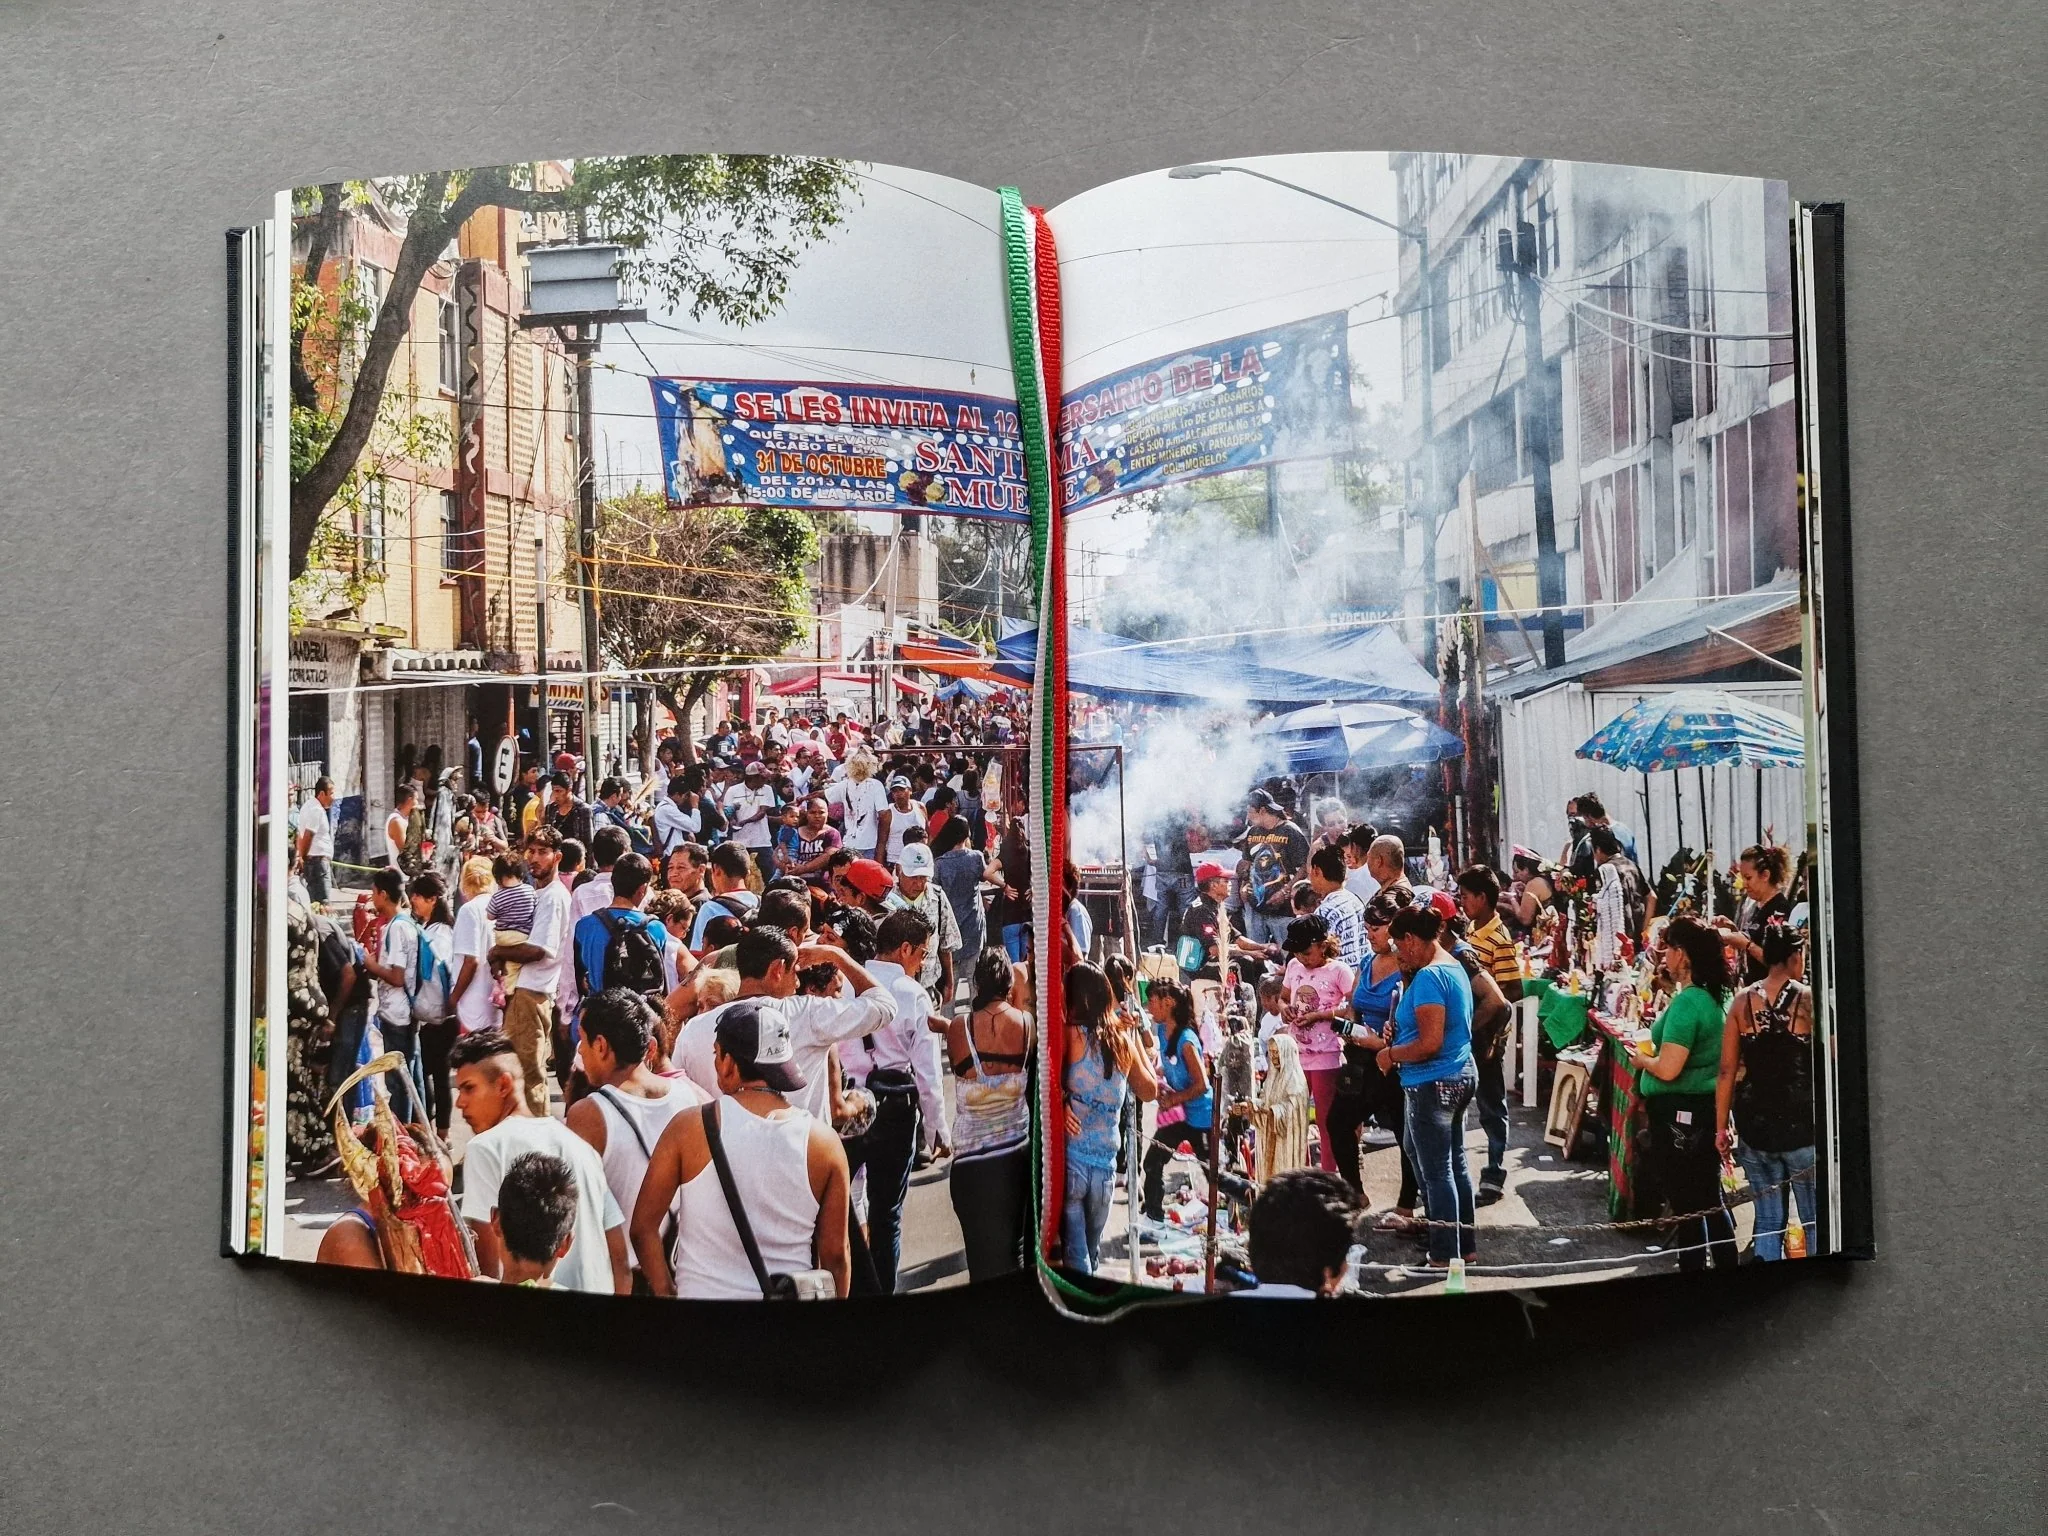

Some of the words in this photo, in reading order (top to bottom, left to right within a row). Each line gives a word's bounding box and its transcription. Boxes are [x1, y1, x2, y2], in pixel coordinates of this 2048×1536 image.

[1172, 357, 1214, 398] DE
[1220, 345, 1264, 384] LA
[734, 391, 776, 422] SE
[784, 393, 842, 424] LES
[849, 396, 950, 431] INVITA
[956, 404, 990, 436] AL
[993, 409, 1020, 441] 12
[749, 429, 784, 441] QUE
[788, 432, 810, 444] SE
[765, 440, 822, 451] ACABO
[827, 443, 847, 454] EL
[1130, 453, 1157, 470] ENTRE
[1158, 442, 1198, 462] MINEROS
[756, 449, 776, 474] 31
[780, 451, 805, 475] DE
[806, 453, 888, 480] OCTUBRE
[1185, 451, 1229, 470] MORELOS
[760, 475, 791, 486] DEL
[797, 477, 835, 487] 2013
[840, 478, 851, 489] A
[856, 480, 887, 490] LAS
[791, 487, 813, 500] DE
[844, 488, 896, 503] TARDE
